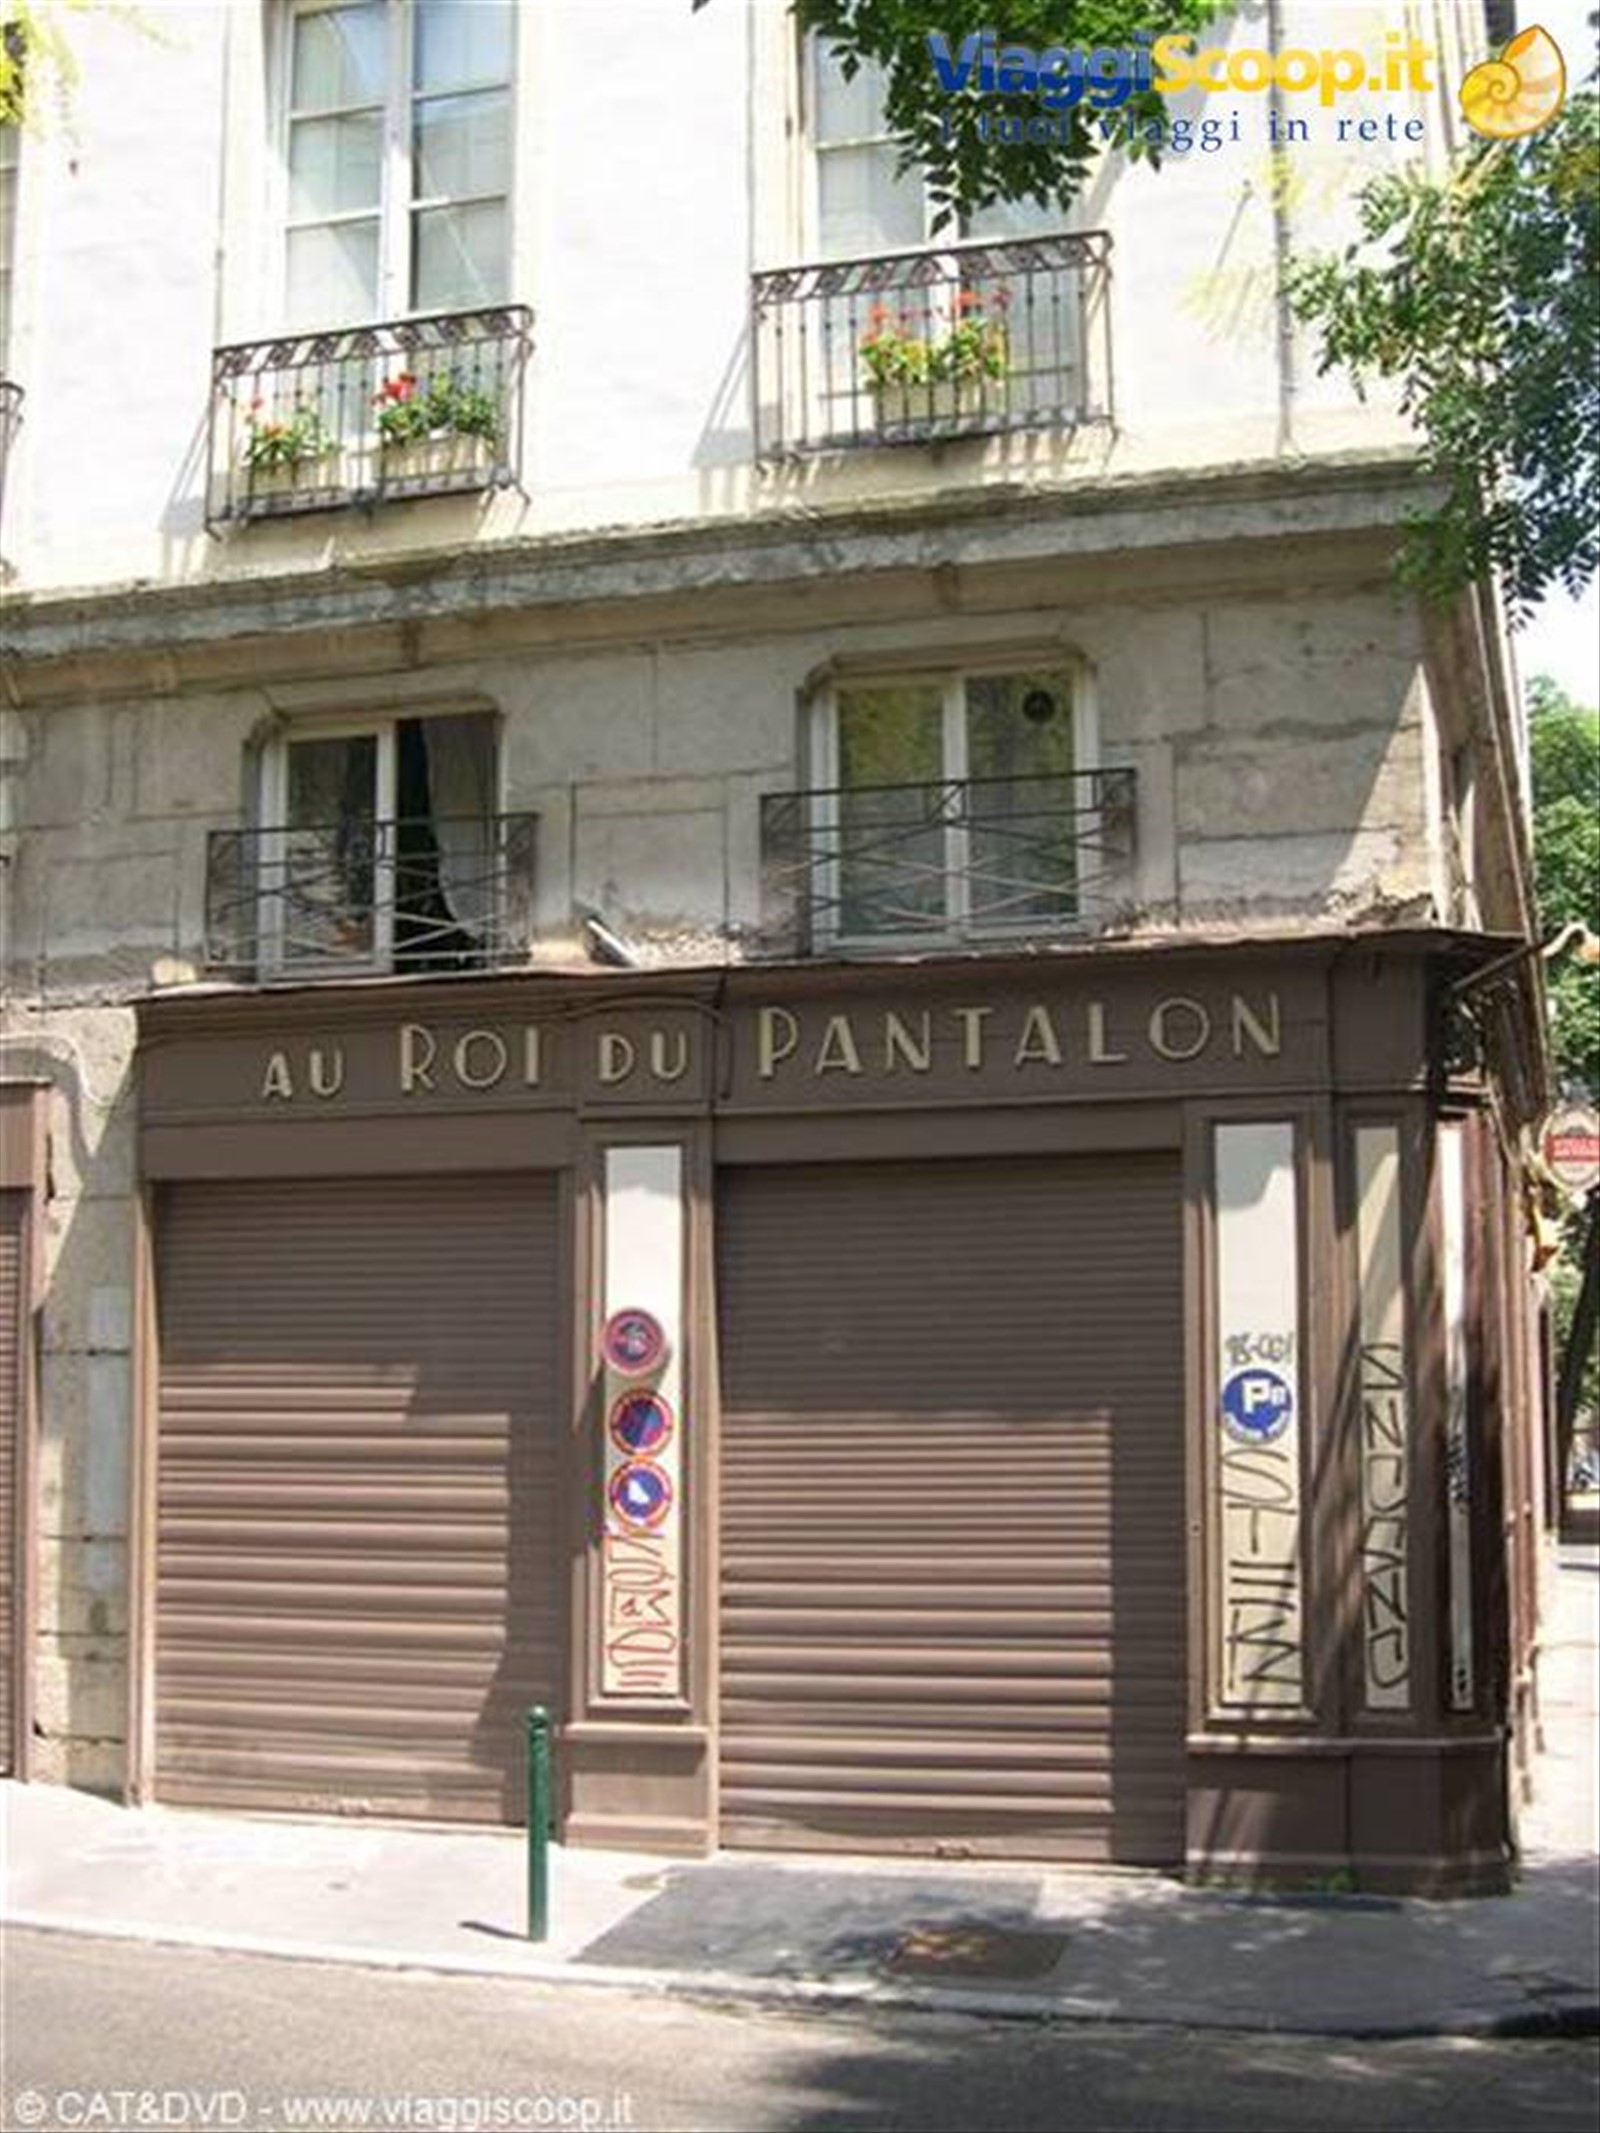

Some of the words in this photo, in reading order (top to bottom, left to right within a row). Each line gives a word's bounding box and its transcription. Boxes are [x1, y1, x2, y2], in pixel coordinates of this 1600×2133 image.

[262, 1049, 344, 1098] AU
[400, 1024, 541, 1092] ROI
[599, 1031, 688, 1084] DU
[757, 994, 1282, 1078] PANTALON
